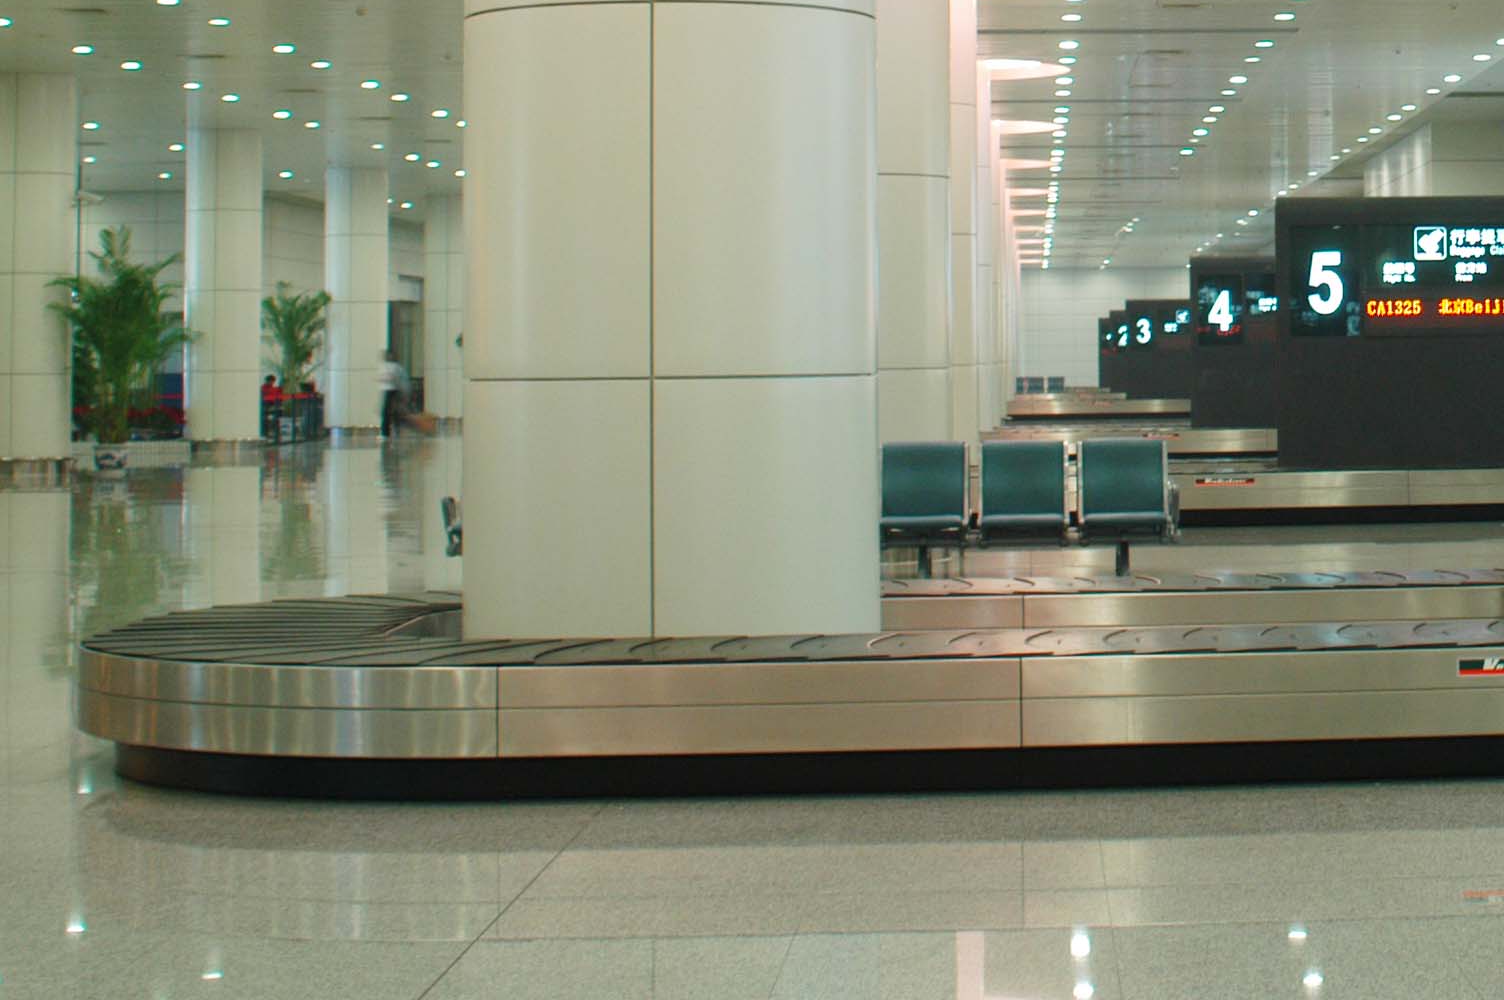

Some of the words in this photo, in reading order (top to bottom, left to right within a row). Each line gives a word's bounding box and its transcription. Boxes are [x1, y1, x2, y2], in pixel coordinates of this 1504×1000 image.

[1307, 250, 1344, 315] 5
[1207, 289, 1234, 332] 4
[1366, 300, 1422, 317] CA1325
[1136, 317, 1152, 344] 3
